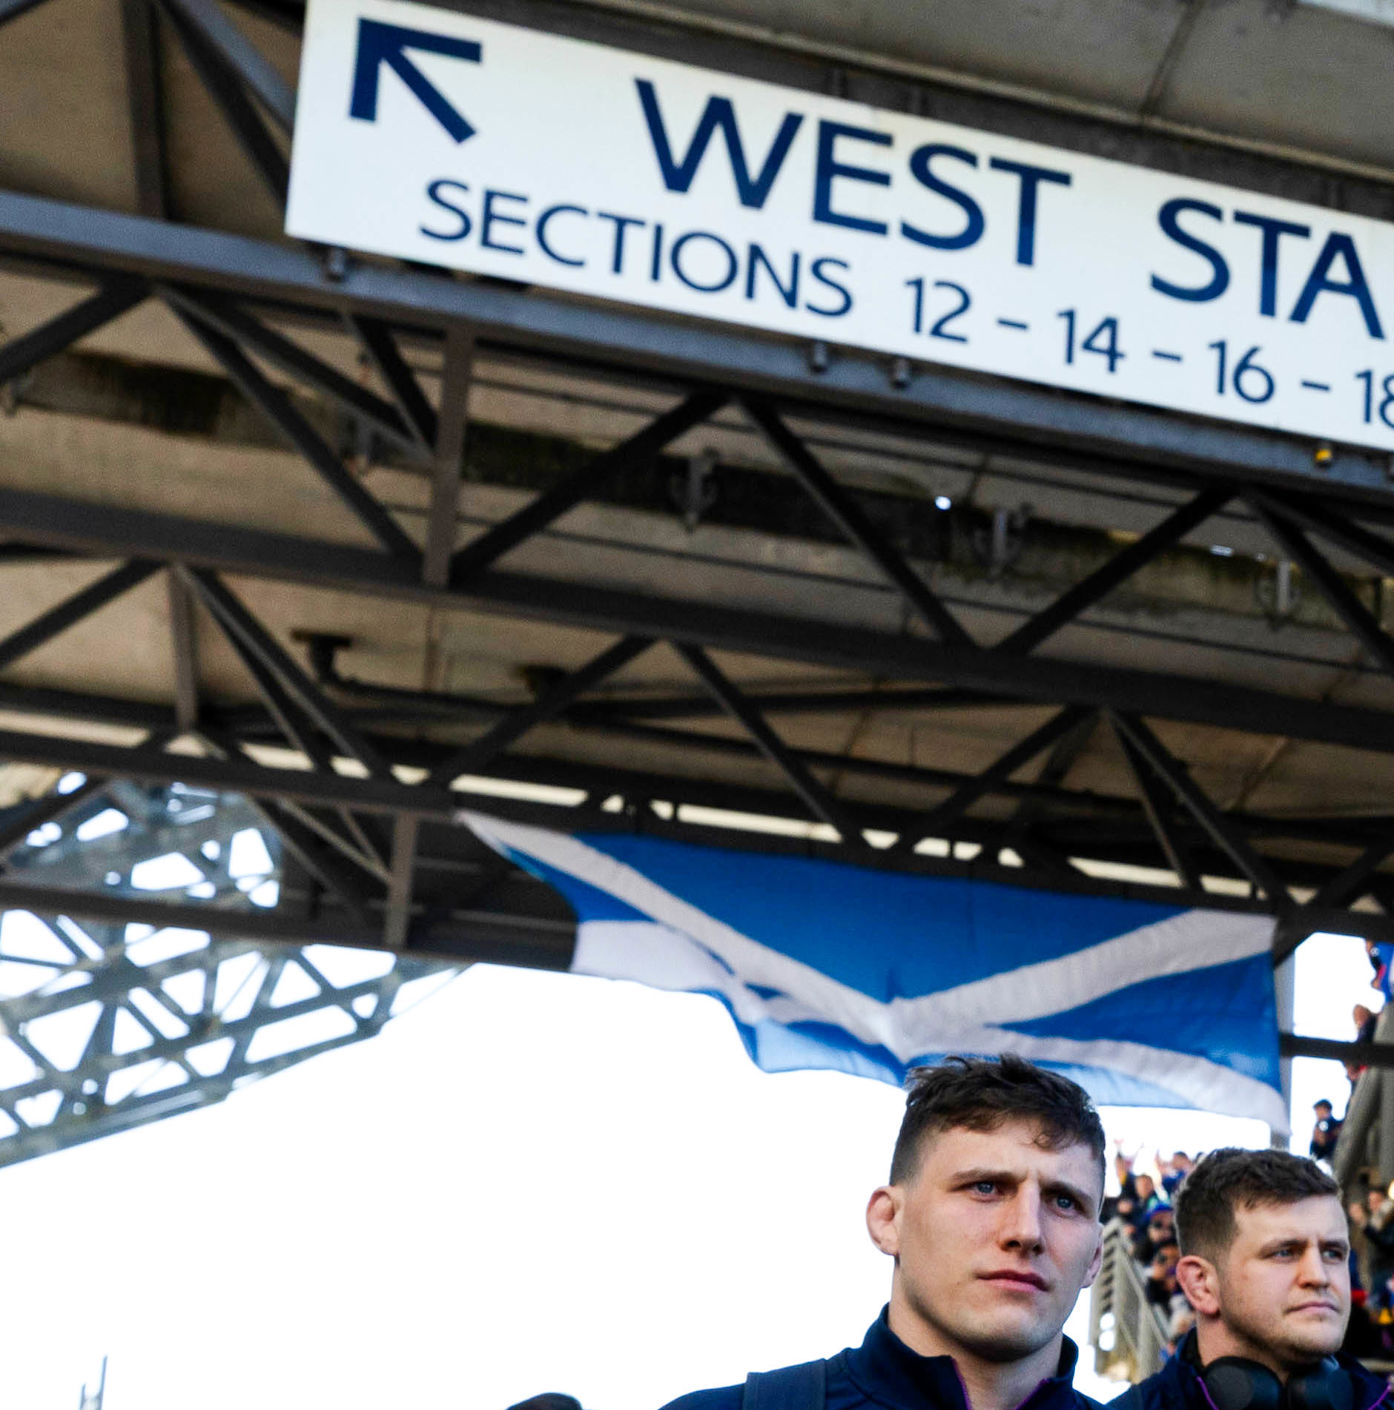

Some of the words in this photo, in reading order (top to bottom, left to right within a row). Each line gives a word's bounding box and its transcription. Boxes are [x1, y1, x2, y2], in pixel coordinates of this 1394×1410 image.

[635, 78, 1072, 266] WEST
[421, 180, 852, 316] SECTIONS
[906, 277, 971, 342] 12
[1058, 309, 1125, 373] 14
[1209, 340, 1275, 404] 16
